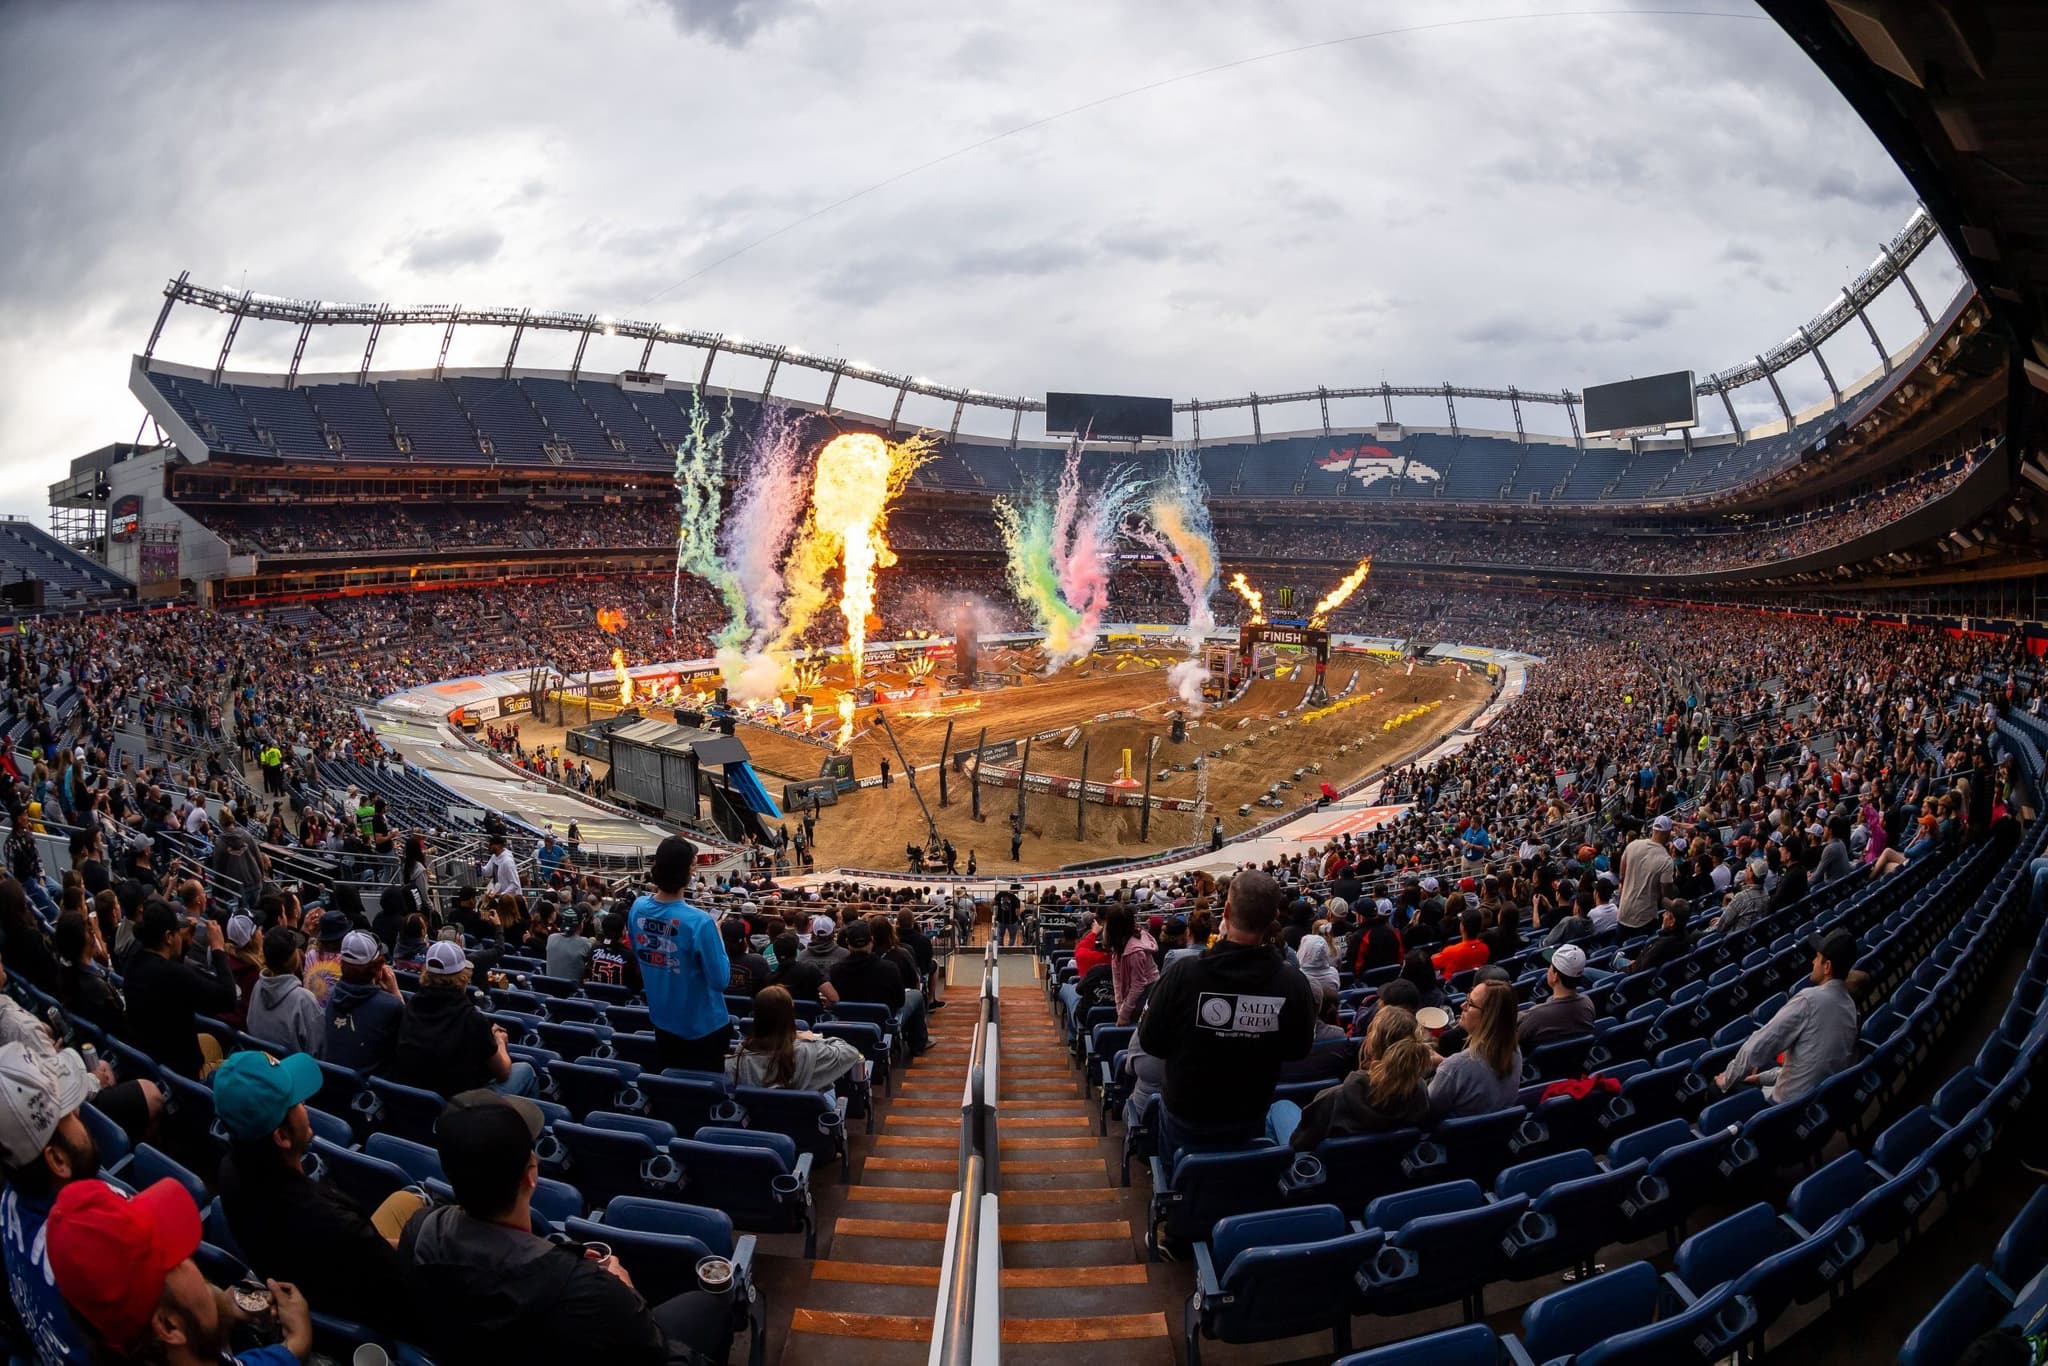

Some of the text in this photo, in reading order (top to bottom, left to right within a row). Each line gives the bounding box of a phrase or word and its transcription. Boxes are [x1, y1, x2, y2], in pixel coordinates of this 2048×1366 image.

[112, 513, 137, 528] EMPOWER
[1263, 631, 1301, 643] FINISH
[693, 670, 716, 678] SPECIAL
[1047, 917, 1066, 925] 128
[592, 960, 622, 985] 51
[1241, 1001, 1278, 1014] SALTY
[1239, 1015, 1273, 1027] CREW
